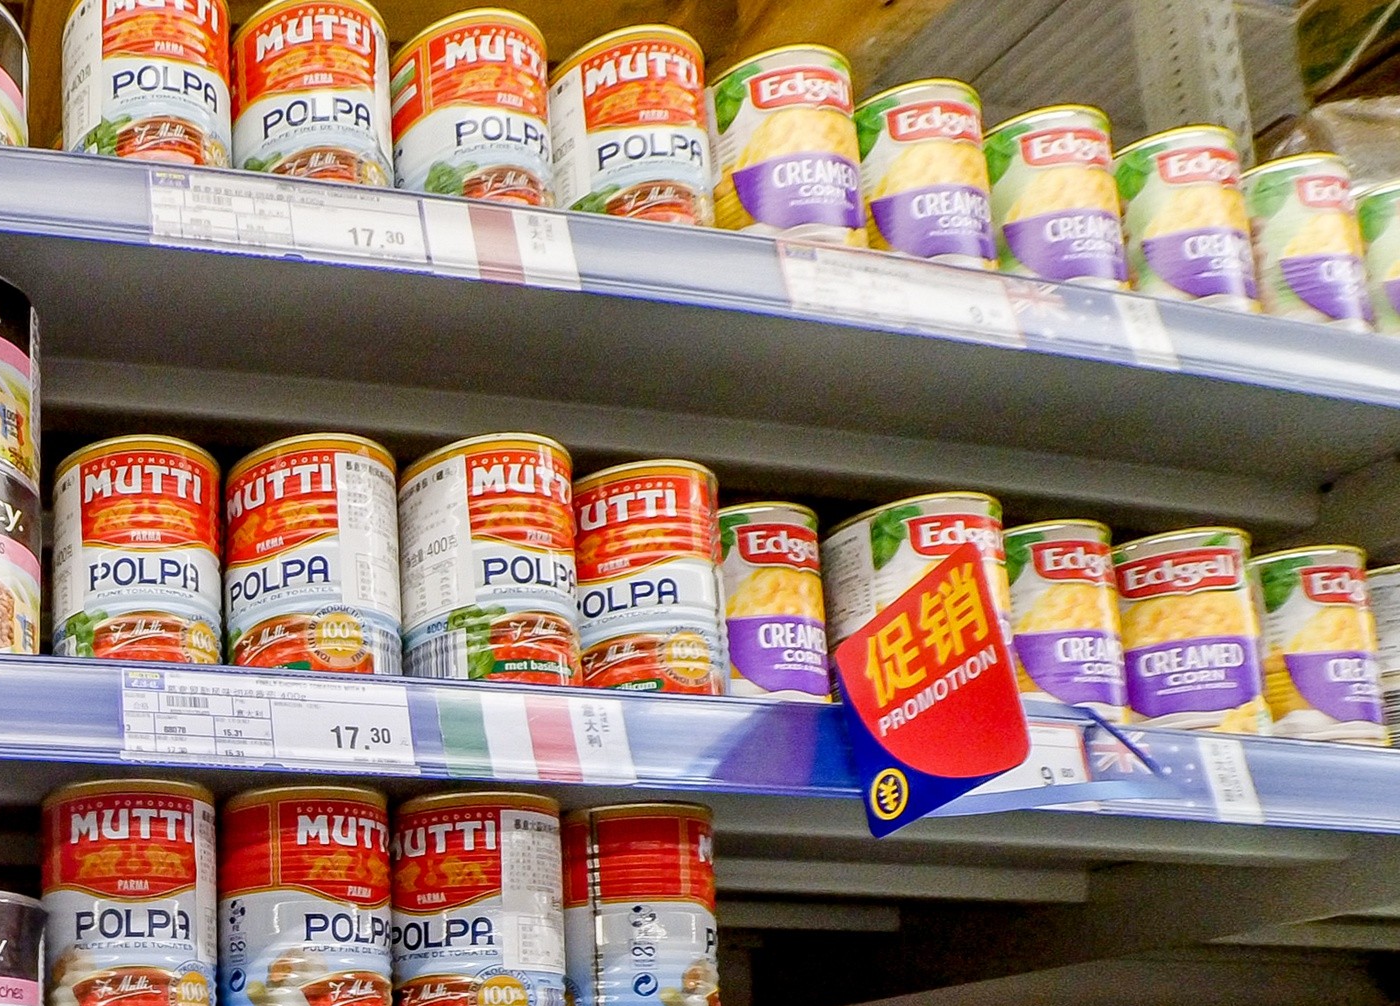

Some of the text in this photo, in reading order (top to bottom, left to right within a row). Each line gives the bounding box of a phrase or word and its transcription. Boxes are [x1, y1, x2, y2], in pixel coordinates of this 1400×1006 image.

[255, 15, 371, 62] MUTTI
[112, 66, 218, 113] POLPA
[585, 51, 699, 97] MUTTI
[263, 97, 371, 139] POLPA
[598, 134, 704, 171] POLPA
[348, 227, 405, 252] 17.30
[83, 465, 202, 504] MUTTI
[130, 531, 162, 542] PARMA
[89, 558, 200, 592] POLPA
[230, 555, 331, 612] POLPA
[1124, 554, 1236, 591] Edgell
[865, 561, 989, 710] 促销
[504, 661, 529, 671] met
[783, 648, 822, 665] CORN
[1139, 644, 1245, 677] CREAMED
[878, 644, 999, 739] PROMOTION
[1166, 670, 1225, 686] CORN
[330, 724, 392, 751] 17.30
[70, 808, 194, 844] MUTTI
[117, 879, 150, 891] PARMA
[75, 909, 191, 941] POLPA
